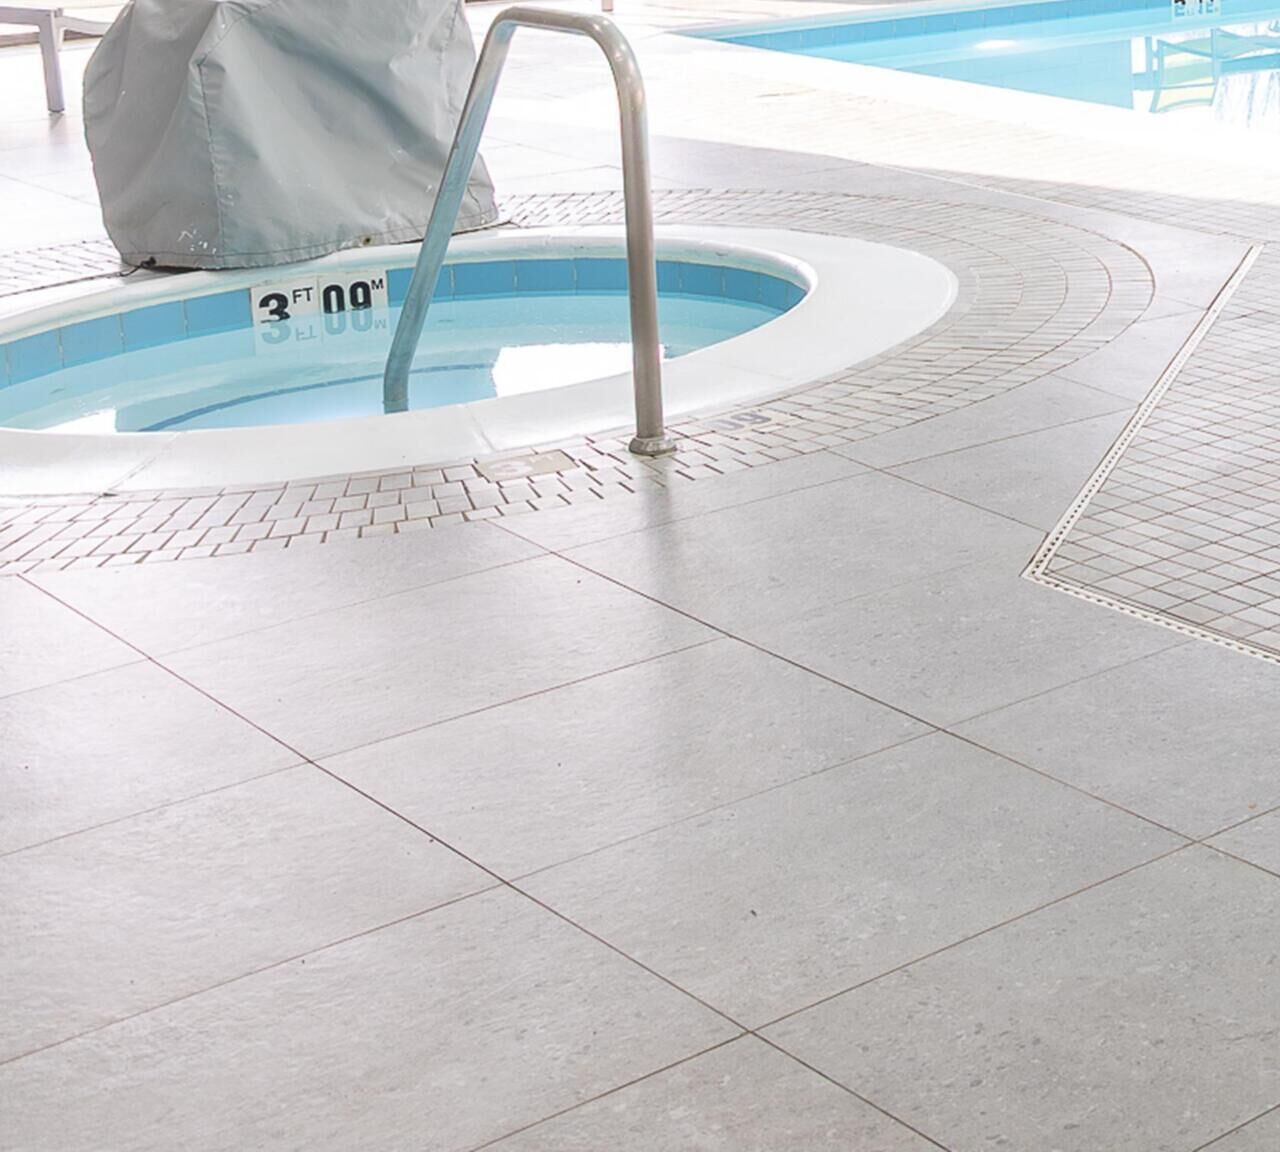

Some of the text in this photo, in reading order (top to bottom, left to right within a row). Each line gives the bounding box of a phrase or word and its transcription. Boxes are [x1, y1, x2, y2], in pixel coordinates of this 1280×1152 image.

[259, 292, 291, 324] 3
[292, 287, 313, 304] FT
[371, 278, 384, 290] M
